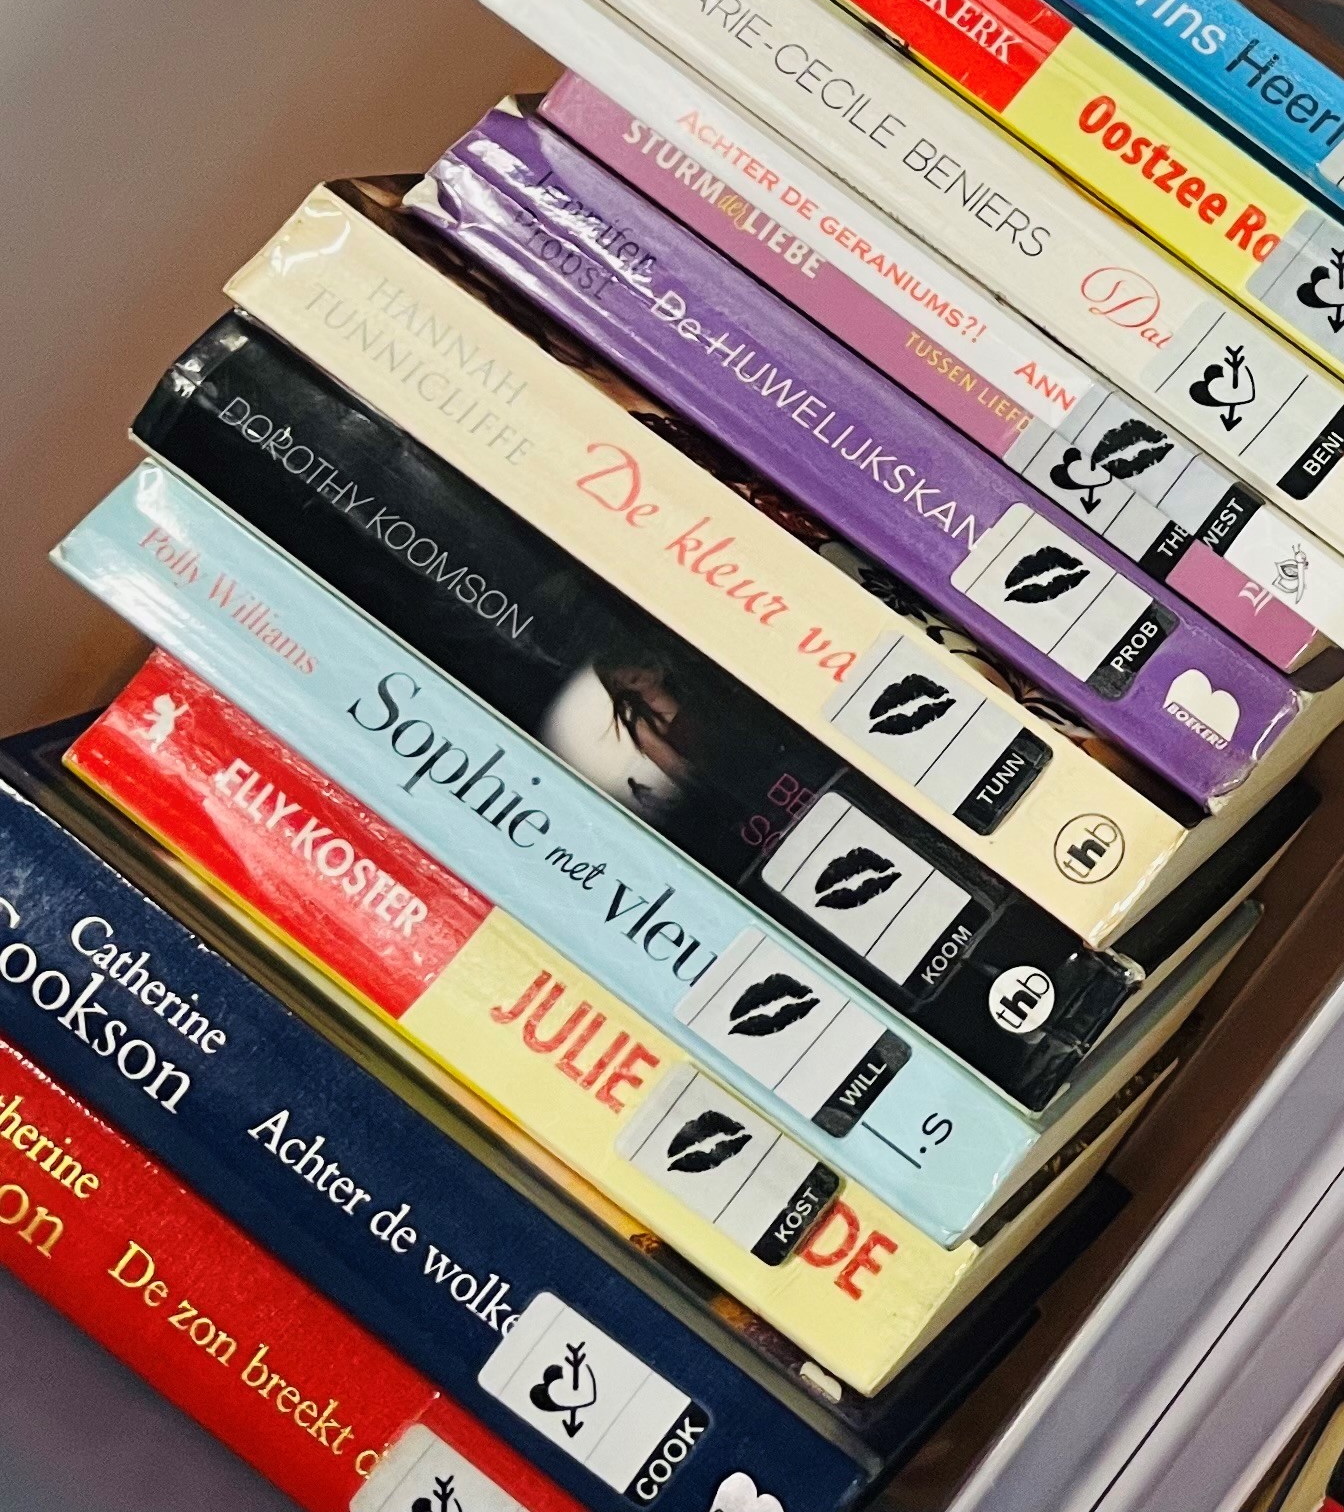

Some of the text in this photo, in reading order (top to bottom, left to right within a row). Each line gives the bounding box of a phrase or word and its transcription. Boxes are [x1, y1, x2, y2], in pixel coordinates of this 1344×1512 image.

[674, 105, 989, 346] ACHTER DE GERANIUMS?!
[897, 135, 1055, 262] BENIERS
[1070, 88, 1239, 228] Oostzee
[297, 282, 540, 470] TUNNICLIFFE
[363, 275, 531, 410] HANNAH
[648, 288, 708, 344] De
[902, 332, 978, 394] TUSSEN
[214, 393, 537, 642] DOROTHY KOOMSON
[1300, 428, 1344, 480] BENI
[564, 432, 803, 632] De kleur
[201, 572, 329, 677] Williams
[1109, 616, 1159, 675] PROB
[328, 658, 607, 894] Sophie met
[976, 749, 1026, 808] TUNN
[211, 756, 436, 941] ELLY KOSTER
[57, 906, 244, 1061] Catherine
[919, 922, 974, 988] KOOM
[483, 957, 665, 1118] JULIE
[838, 1052, 888, 1111] WILL
[241, 1099, 430, 1259] Achter de
[771, 1185, 824, 1248] KOST
[103, 1238, 367, 1459] De zon breekt
[630, 1414, 705, 1505] COOK
